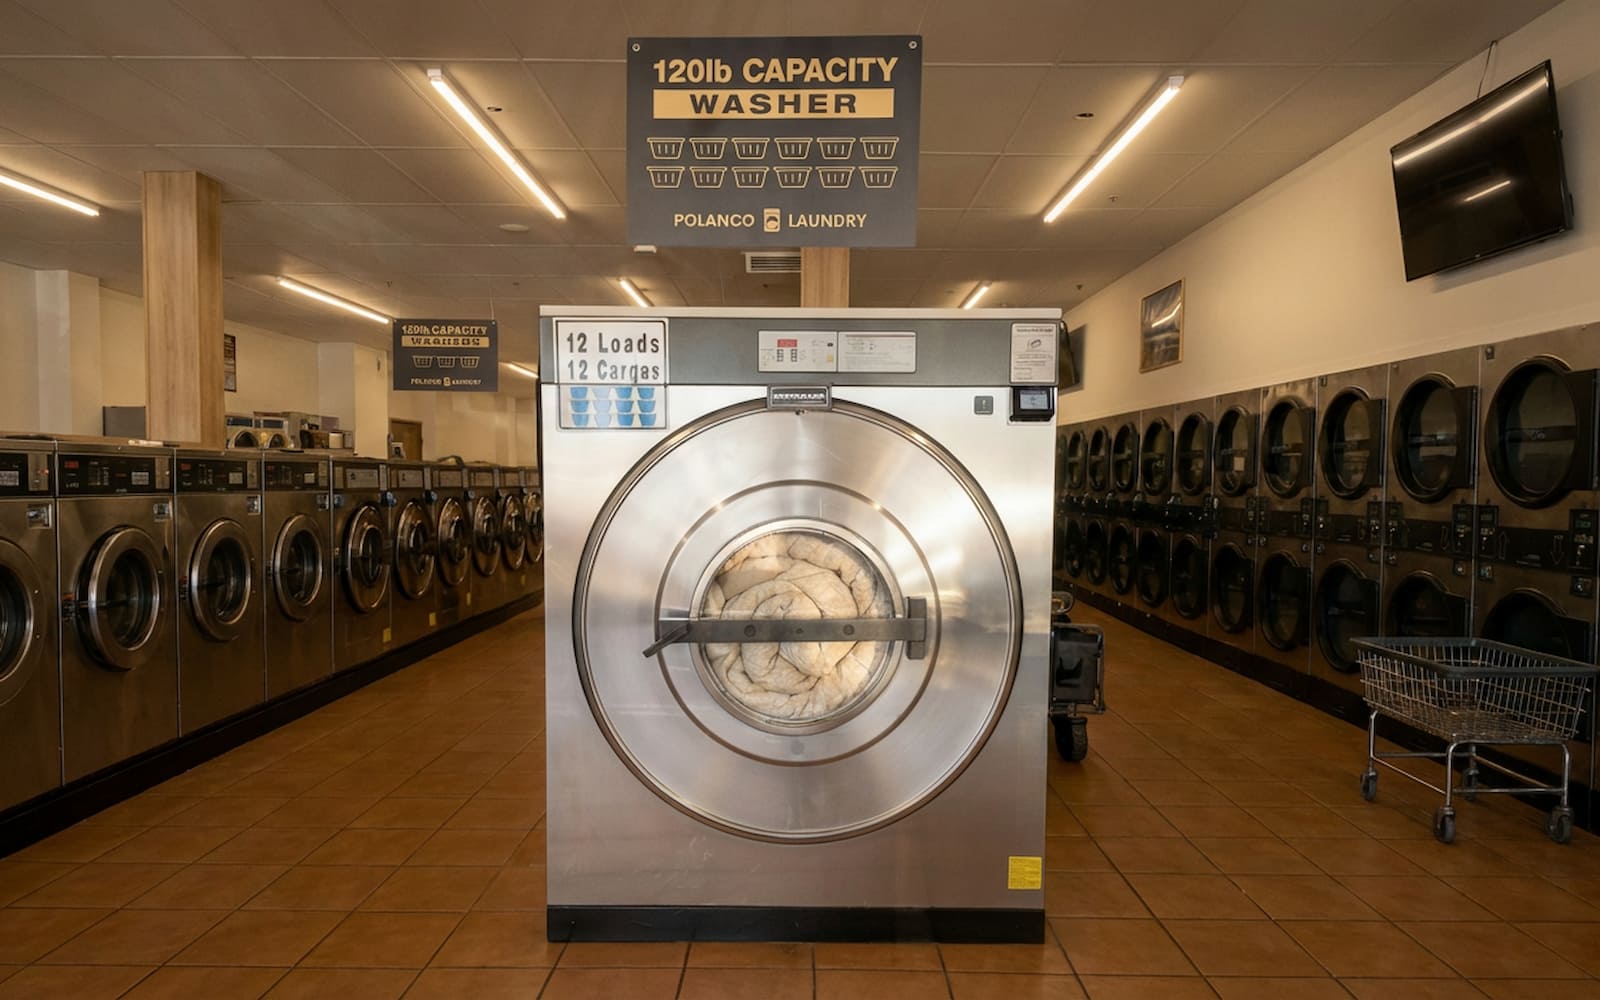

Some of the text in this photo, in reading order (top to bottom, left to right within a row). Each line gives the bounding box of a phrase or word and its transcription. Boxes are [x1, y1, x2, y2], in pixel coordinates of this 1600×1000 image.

[653, 56, 898, 84] 120lb CAPACITY
[689, 93, 857, 115] WASHER
[674, 213, 867, 228] POLANCO LAUNDRY
[567, 332, 660, 354] 12 Loads
[568, 359, 660, 383] 12 Cargas
